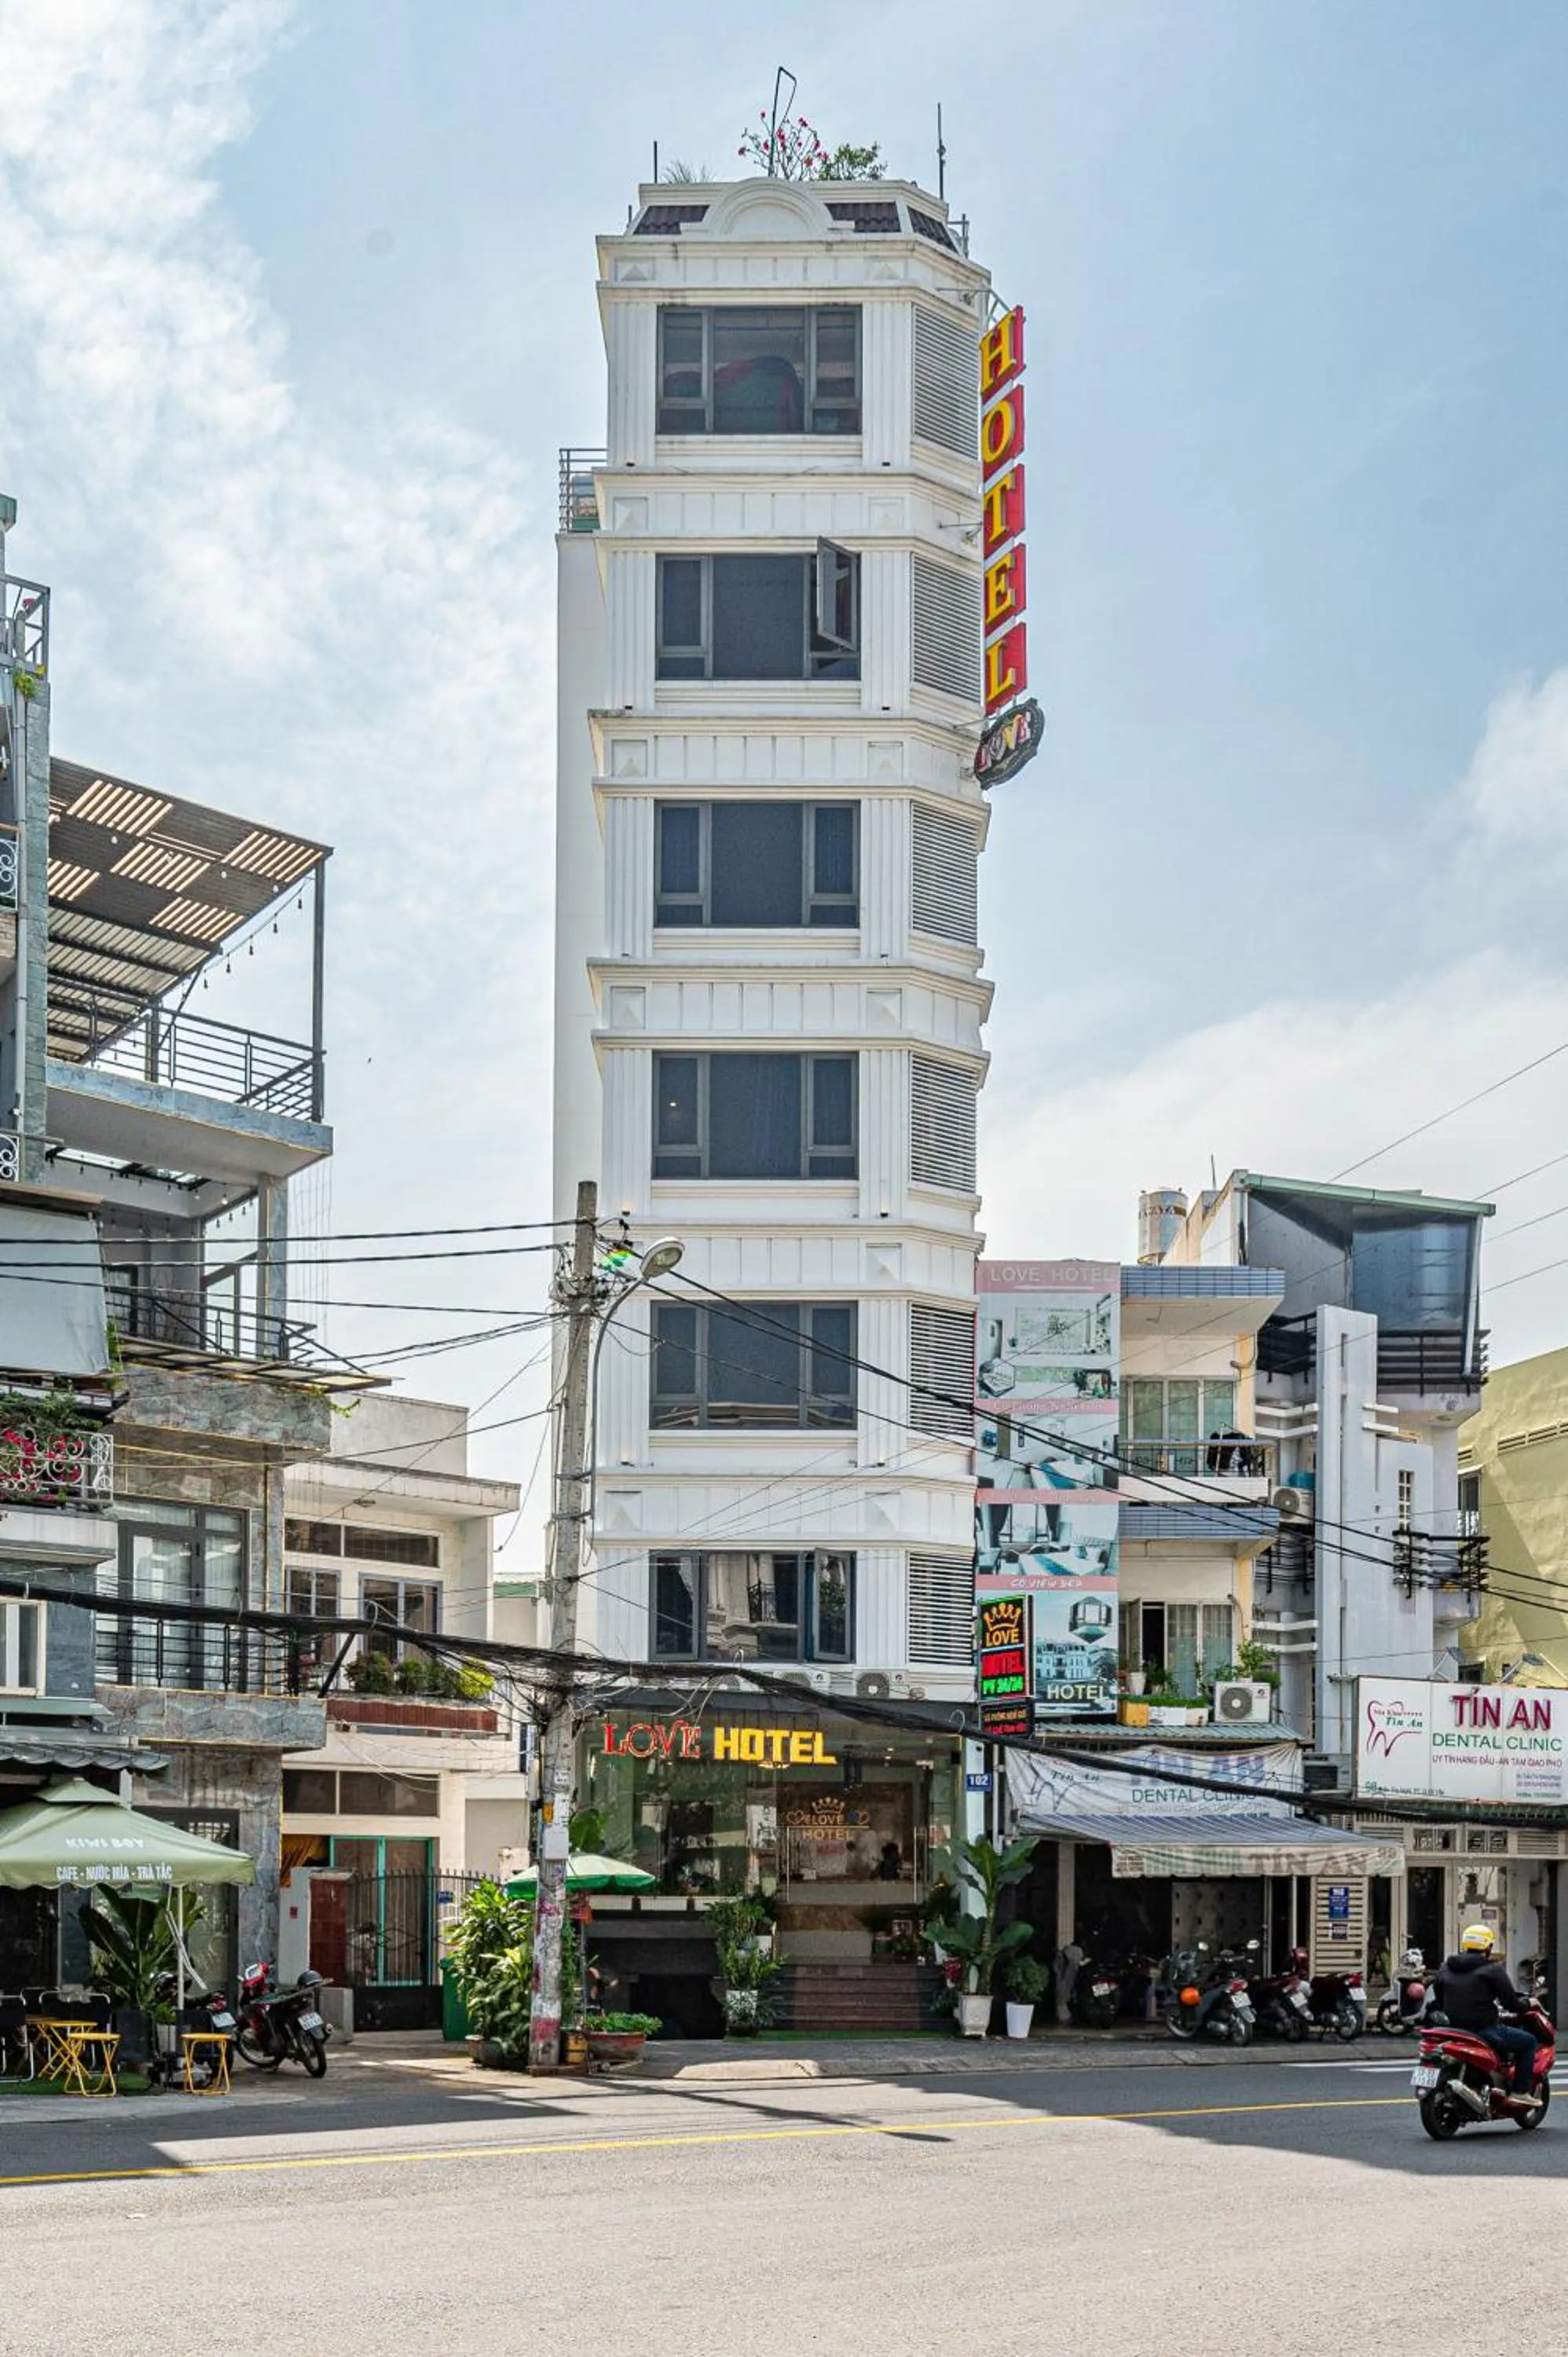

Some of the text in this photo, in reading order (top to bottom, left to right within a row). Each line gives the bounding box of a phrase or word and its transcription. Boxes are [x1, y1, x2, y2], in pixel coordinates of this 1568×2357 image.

[979, 311, 1017, 702] HOTEL
[991, 1267, 1115, 1283] LOVE HOTEL
[986, 1629, 1019, 1647] LOVE
[1046, 1684, 1109, 1700] HOTEL
[1451, 1687, 1552, 1731] TÍN AN
[603, 1720, 837, 1765] LOVE HOTEL
[1432, 1732, 1563, 1751] DENTAL CLINIC
[969, 1775, 988, 1786] 102
[1132, 1787, 1196, 1803] DENTAL
[811, 1814, 844, 1825] LOVE
[802, 1829, 854, 1840] HOTEL
[111, 1838, 144, 1849] BOY
[57, 1866, 78, 1880] CAFE
[112, 1863, 130, 1880] MÍA
